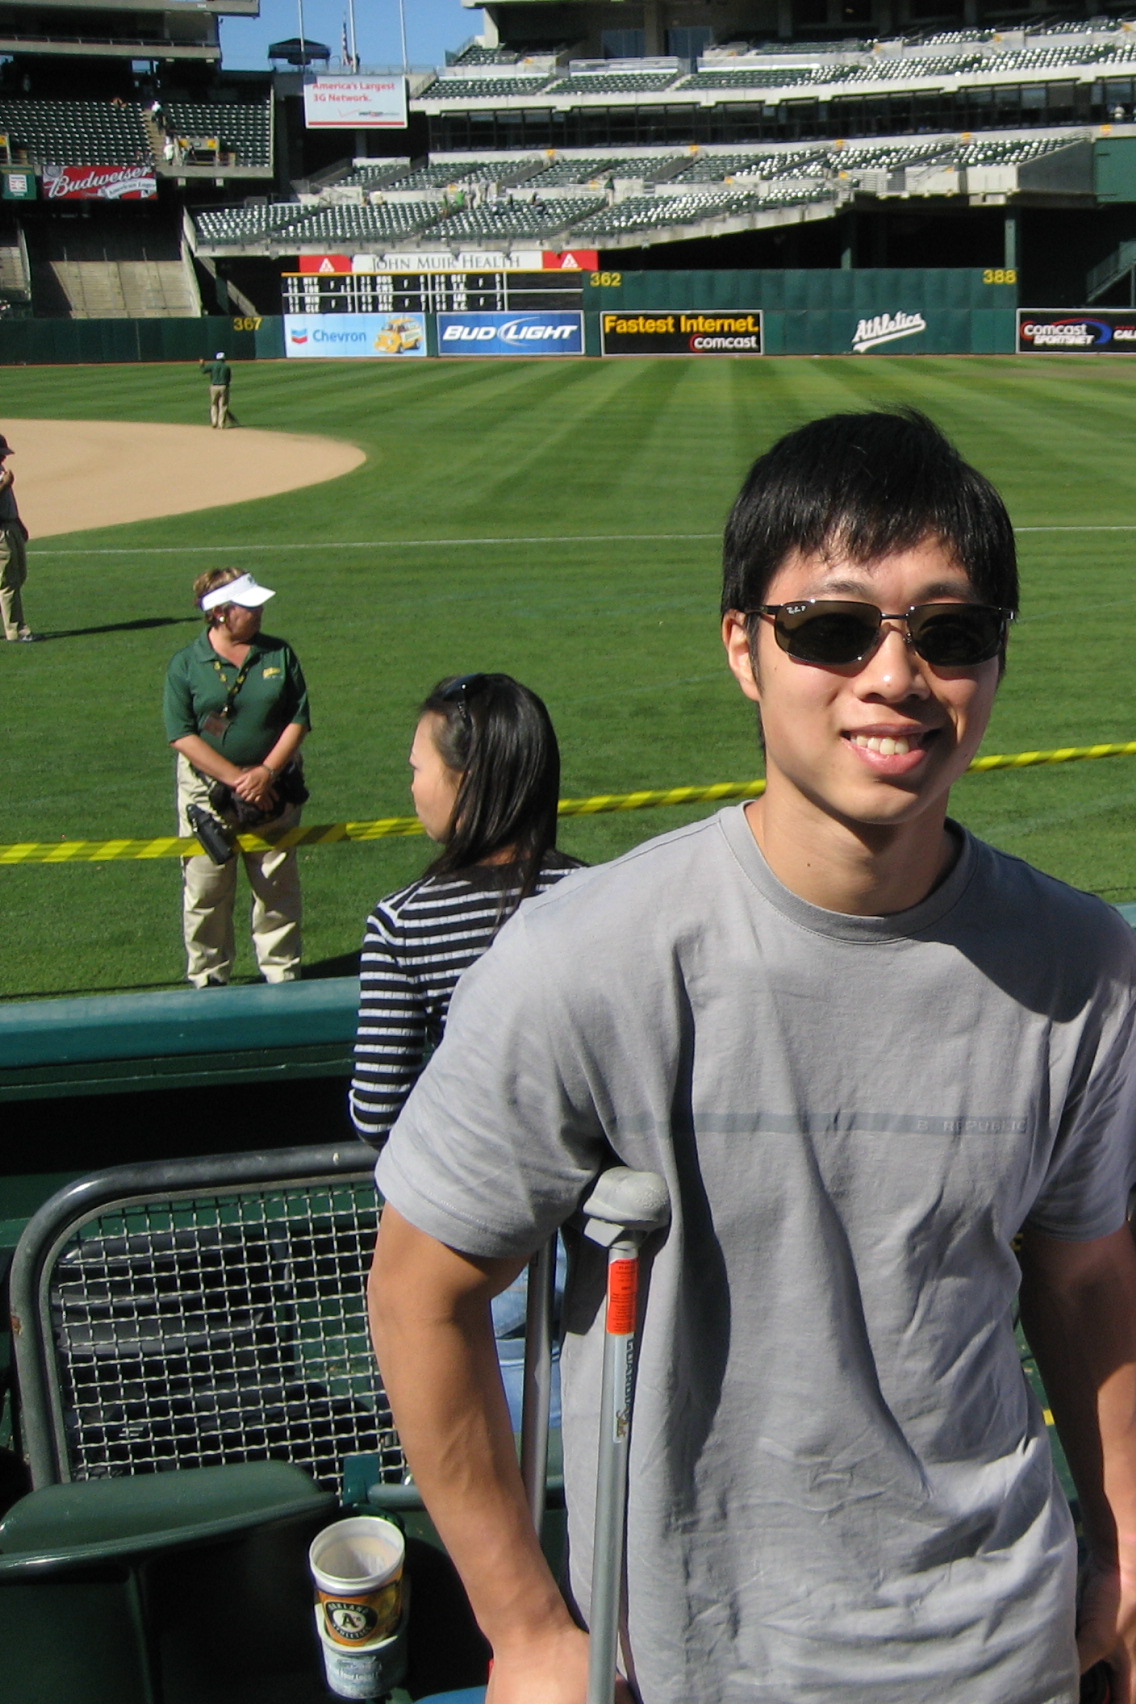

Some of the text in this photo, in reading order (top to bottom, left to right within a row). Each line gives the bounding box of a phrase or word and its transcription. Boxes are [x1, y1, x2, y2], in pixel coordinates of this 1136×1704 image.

[360, 82, 395, 93] Largest
[314, 94, 327, 102] 3G
[46, 166, 153, 198] Budweiser
[370, 254, 521, 272] JOHN MUIR HEALTH
[590, 272, 622, 287] 362
[983, 269, 1017, 285] 388
[233, 317, 263, 331] 367
[604, 315, 759, 333] Fastest Internet.
[852, 310, 924, 346] Athletics
[1023, 324, 1088, 336] comcast
[312, 329, 367, 342] Chevron
[443, 325, 578, 341] BUD LIGHT
[692, 335, 758, 350] comcast
[943, 1120, 1027, 1133] REPUBLIC
